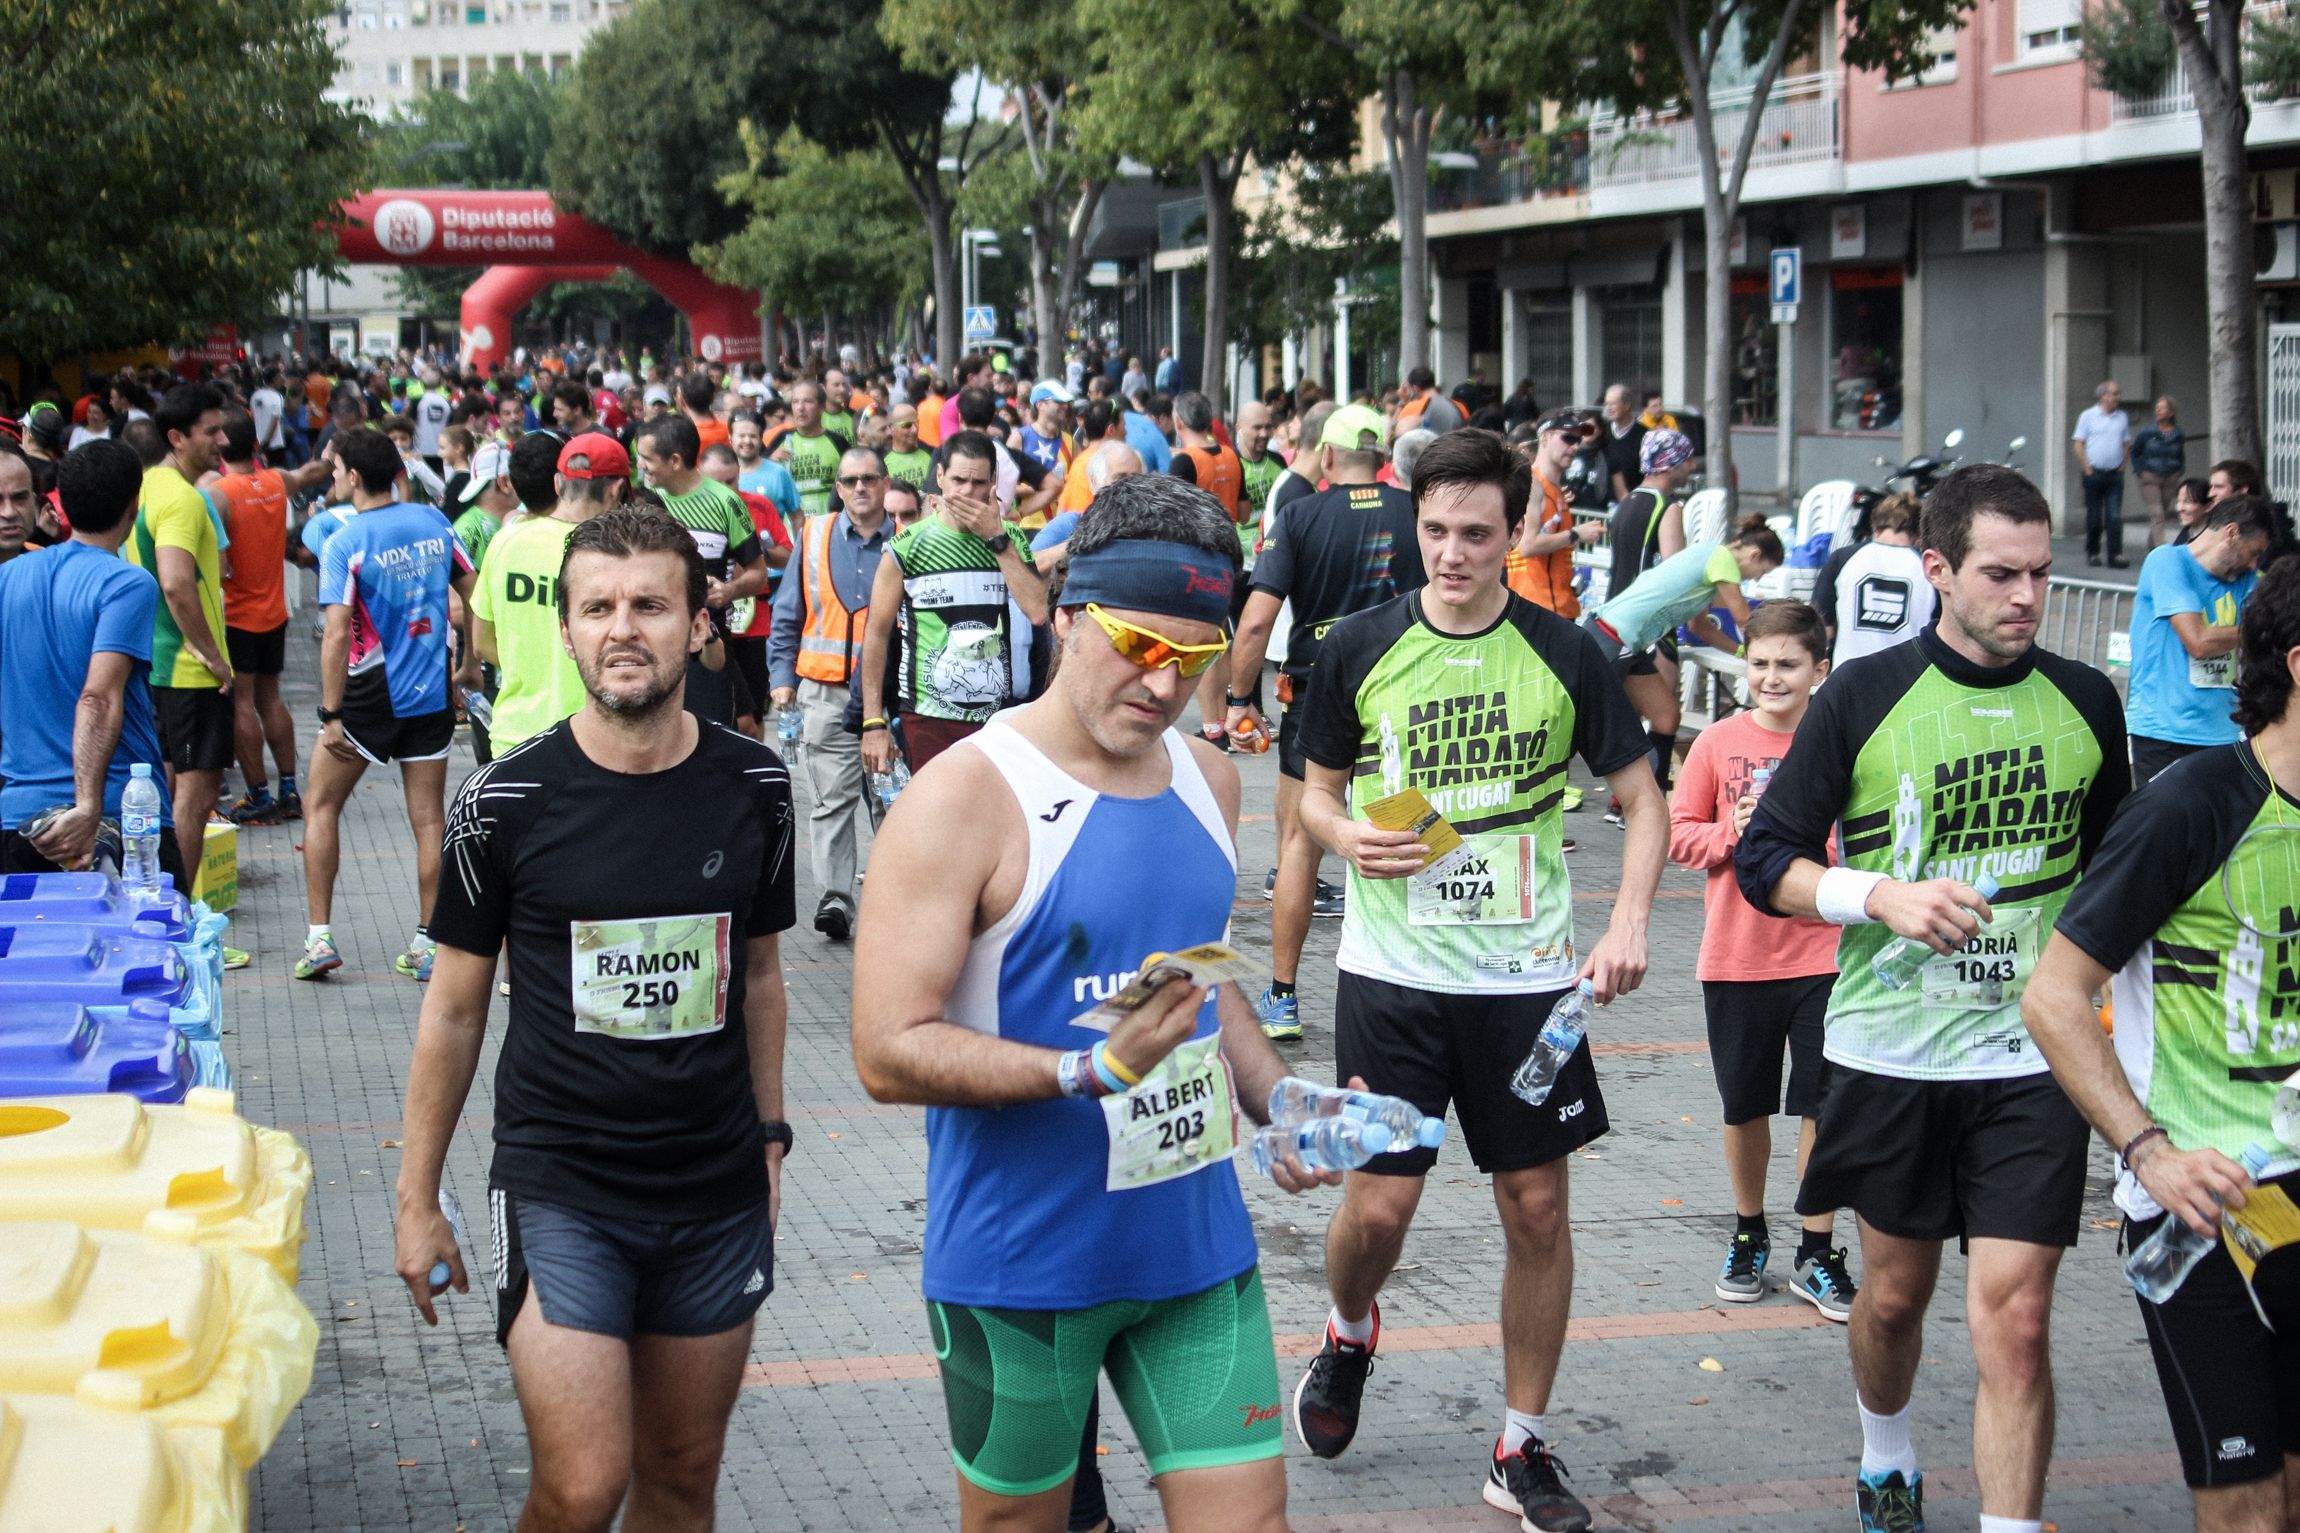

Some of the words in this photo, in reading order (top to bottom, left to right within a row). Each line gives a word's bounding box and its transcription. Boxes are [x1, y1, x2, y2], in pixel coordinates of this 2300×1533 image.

[442, 207, 556, 231] Diputació
[442, 231, 555, 250] Barcelona
[1775, 256, 1793, 299] P
[373, 543, 412, 569] VDX
[414, 537, 445, 557] TRI
[1408, 719, 1548, 789] MARATÓ
[1425, 788, 1454, 815] NT
[1457, 781, 1512, 812] CUGAT
[1929, 777, 2088, 857] MARATÓ
[1449, 859, 1490, 876] AX
[1924, 855, 1977, 882] SANT
[1980, 846, 2046, 878] CUGAT
[1436, 880, 1495, 901] 1074
[597, 949, 700, 976] RAMON
[1954, 959, 2016, 983] 1043
[622, 980, 679, 1009] 250
[1131, 1072, 1216, 1121] ALBERT
[1158, 1110, 1206, 1150] 203
